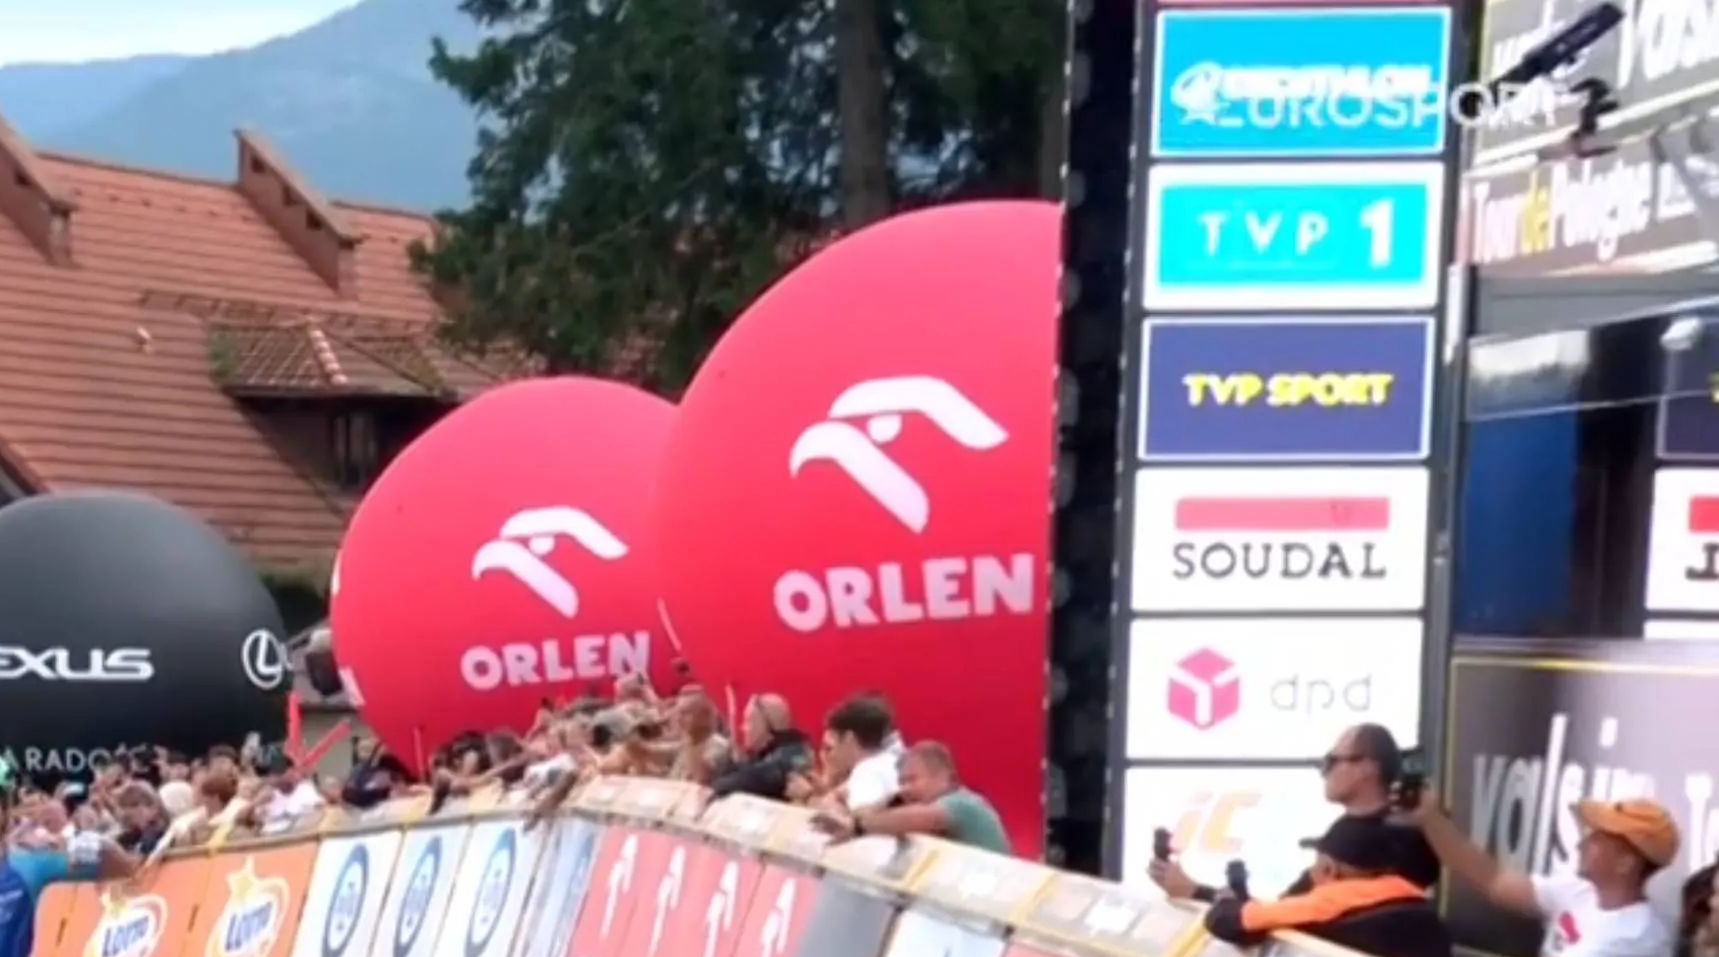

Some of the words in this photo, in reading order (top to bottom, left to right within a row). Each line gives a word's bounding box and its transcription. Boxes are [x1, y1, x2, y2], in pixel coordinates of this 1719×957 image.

[1198, 211, 1329, 255] TVP
[1360, 198, 1395, 269] 1
[1181, 373, 1264, 408] TVP
[1266, 373, 1394, 408] SPORT
[1172, 543, 1387, 580] SOUDAL
[773, 553, 1035, 632] ORLEN
[460, 630, 652, 690] ORLEN
[1270, 674, 1373, 715] dpd
